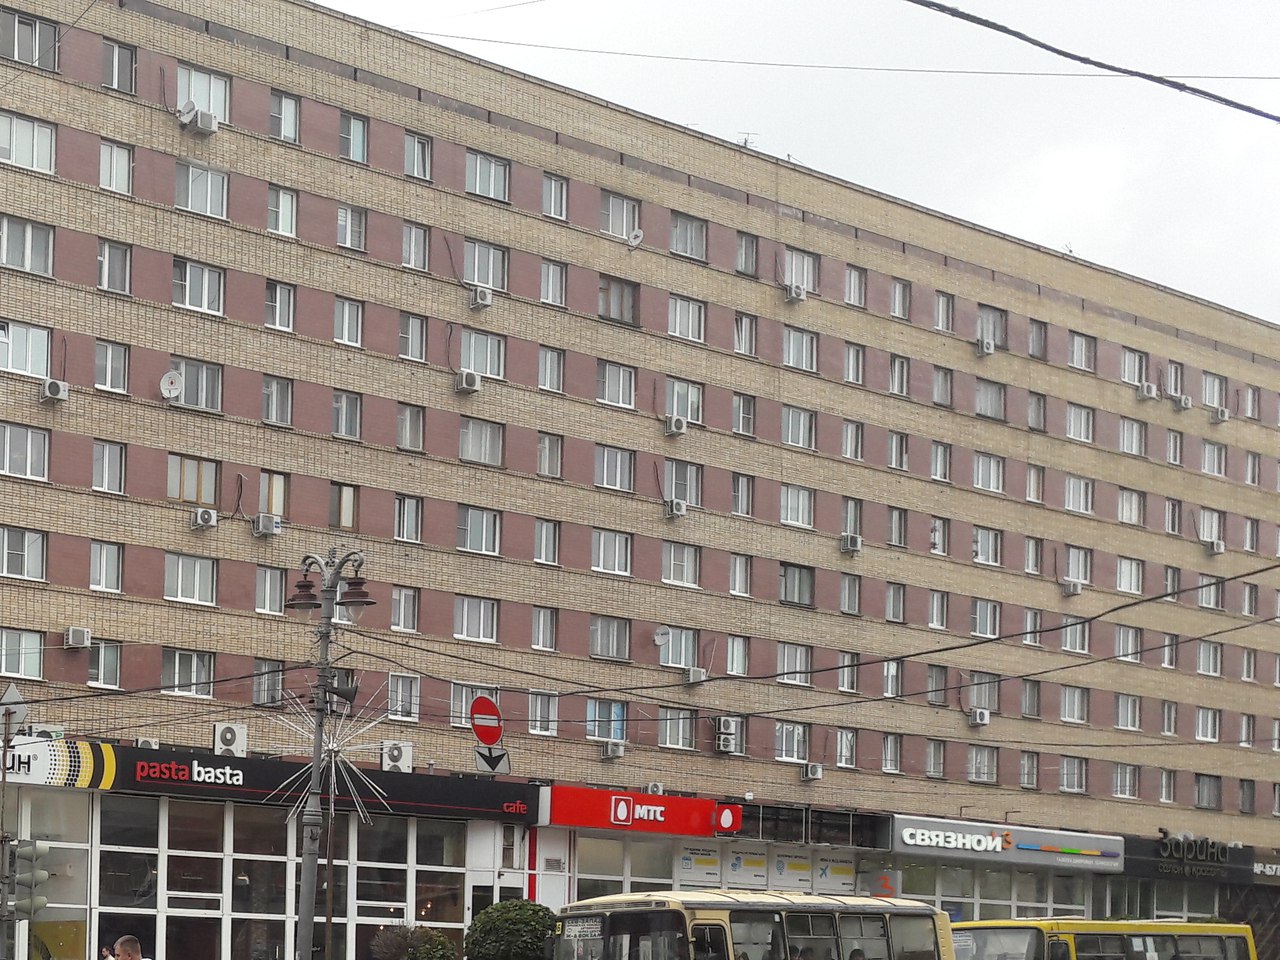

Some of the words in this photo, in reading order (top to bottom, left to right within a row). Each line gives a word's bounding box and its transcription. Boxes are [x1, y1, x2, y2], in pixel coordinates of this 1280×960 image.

[136, 759, 189, 781] pasta
[192, 761, 244, 786] basta
[503, 801, 527, 814] cafe
[634, 804, 665, 822] МТС
[901, 827, 1003, 853] СВЯЗНОЙ
[1158, 827, 1229, 862] Зарина
